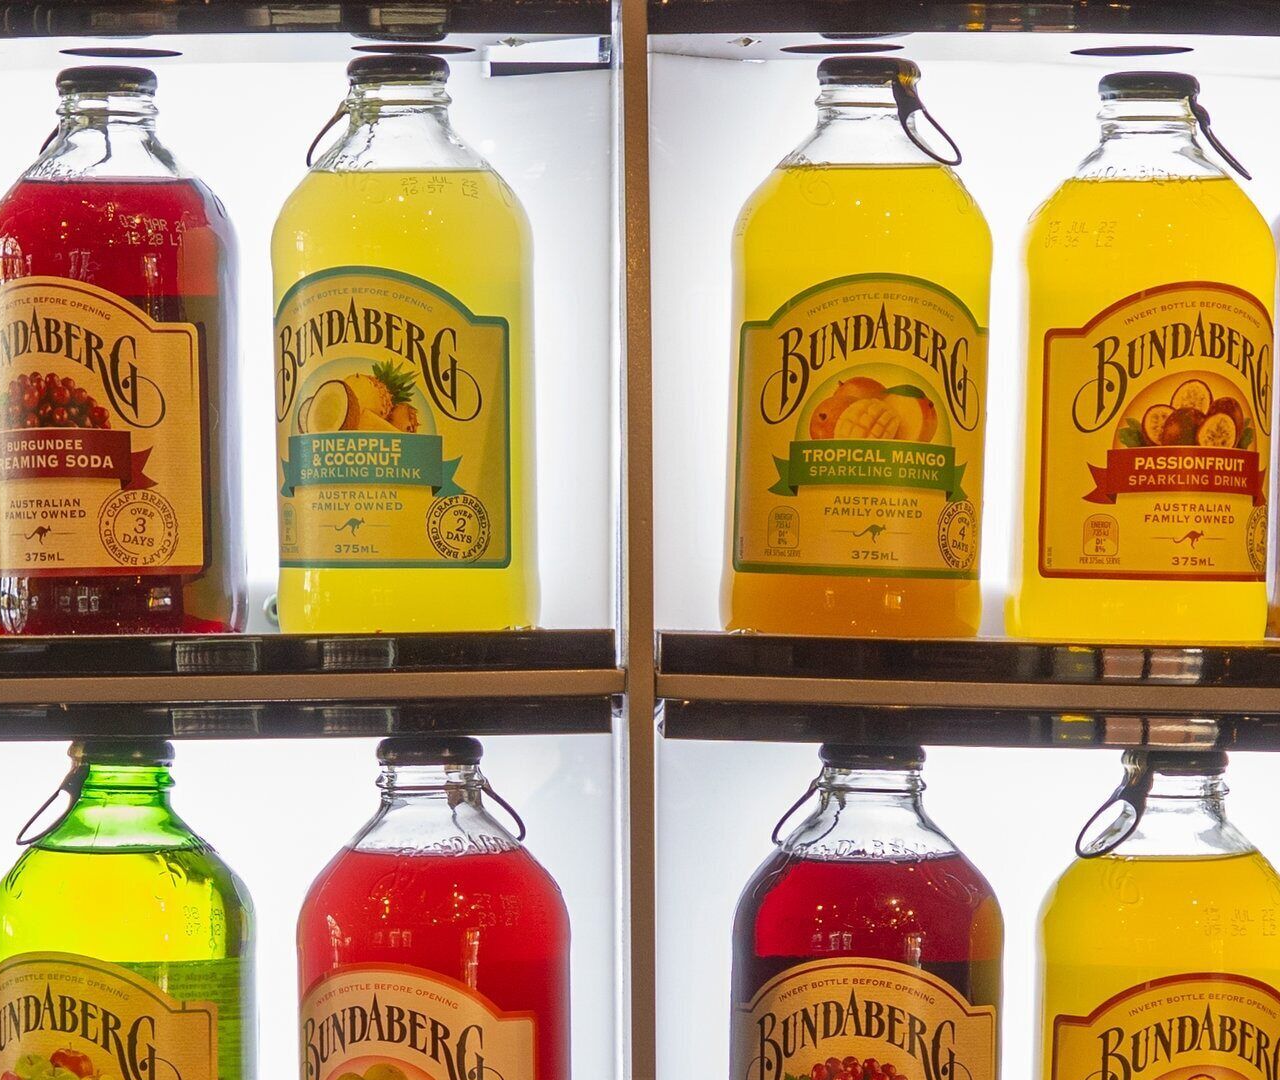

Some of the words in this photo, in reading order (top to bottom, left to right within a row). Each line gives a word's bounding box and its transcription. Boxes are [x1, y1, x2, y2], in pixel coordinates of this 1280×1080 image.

[275, 296, 482, 422] BUNDABERG
[760, 302, 979, 431] BUNDABERG
[7, 440, 83, 450] BURGUNDEE
[312, 439, 402, 452] PINEAPPLE
[65, 455, 113, 469] SODA
[312, 454, 322, 466] &
[324, 453, 401, 466] COCONUT
[803, 449, 885, 463] TROPICAL
[892, 451, 946, 466] MANGO
[1135, 457, 1244, 471] PASSIONFRUIT
[301, 467, 370, 479] SPARKLING
[375, 467, 420, 479] DRINK
[809, 466, 892, 477] SPARKLING
[899, 467, 939, 480] DRINK
[1128, 474, 1209, 486] SPARKLING
[1214, 475, 1247, 487] DRINK
[318, 490, 397, 500] AUSTRALIAN
[834, 496, 918, 507] AUSTRALIAN
[10, 498, 81, 509] AUSTRALIAN
[312, 501, 351, 511] FAMILY
[354, 501, 403, 511] OWNED
[1154, 502, 1231, 513] AUSTRALIAN
[5, 510, 38, 519] FAMILY
[41, 509, 86, 519] OWNED
[130, 507, 155, 519] OVER
[824, 506, 871, 517] FAMILY
[876, 508, 922, 518] OWNED
[1144, 514, 1190, 523] FAMILY
[1195, 514, 1235, 524] OWNED
[134, 518, 146, 534] 3
[123, 533, 155, 547] DAYS
[779, 985, 808, 1002] INVERT
[811, 978, 849, 988] BOTTLE
[852, 978, 891, 989] BEFORE
[895, 983, 935, 1005] OPENING
